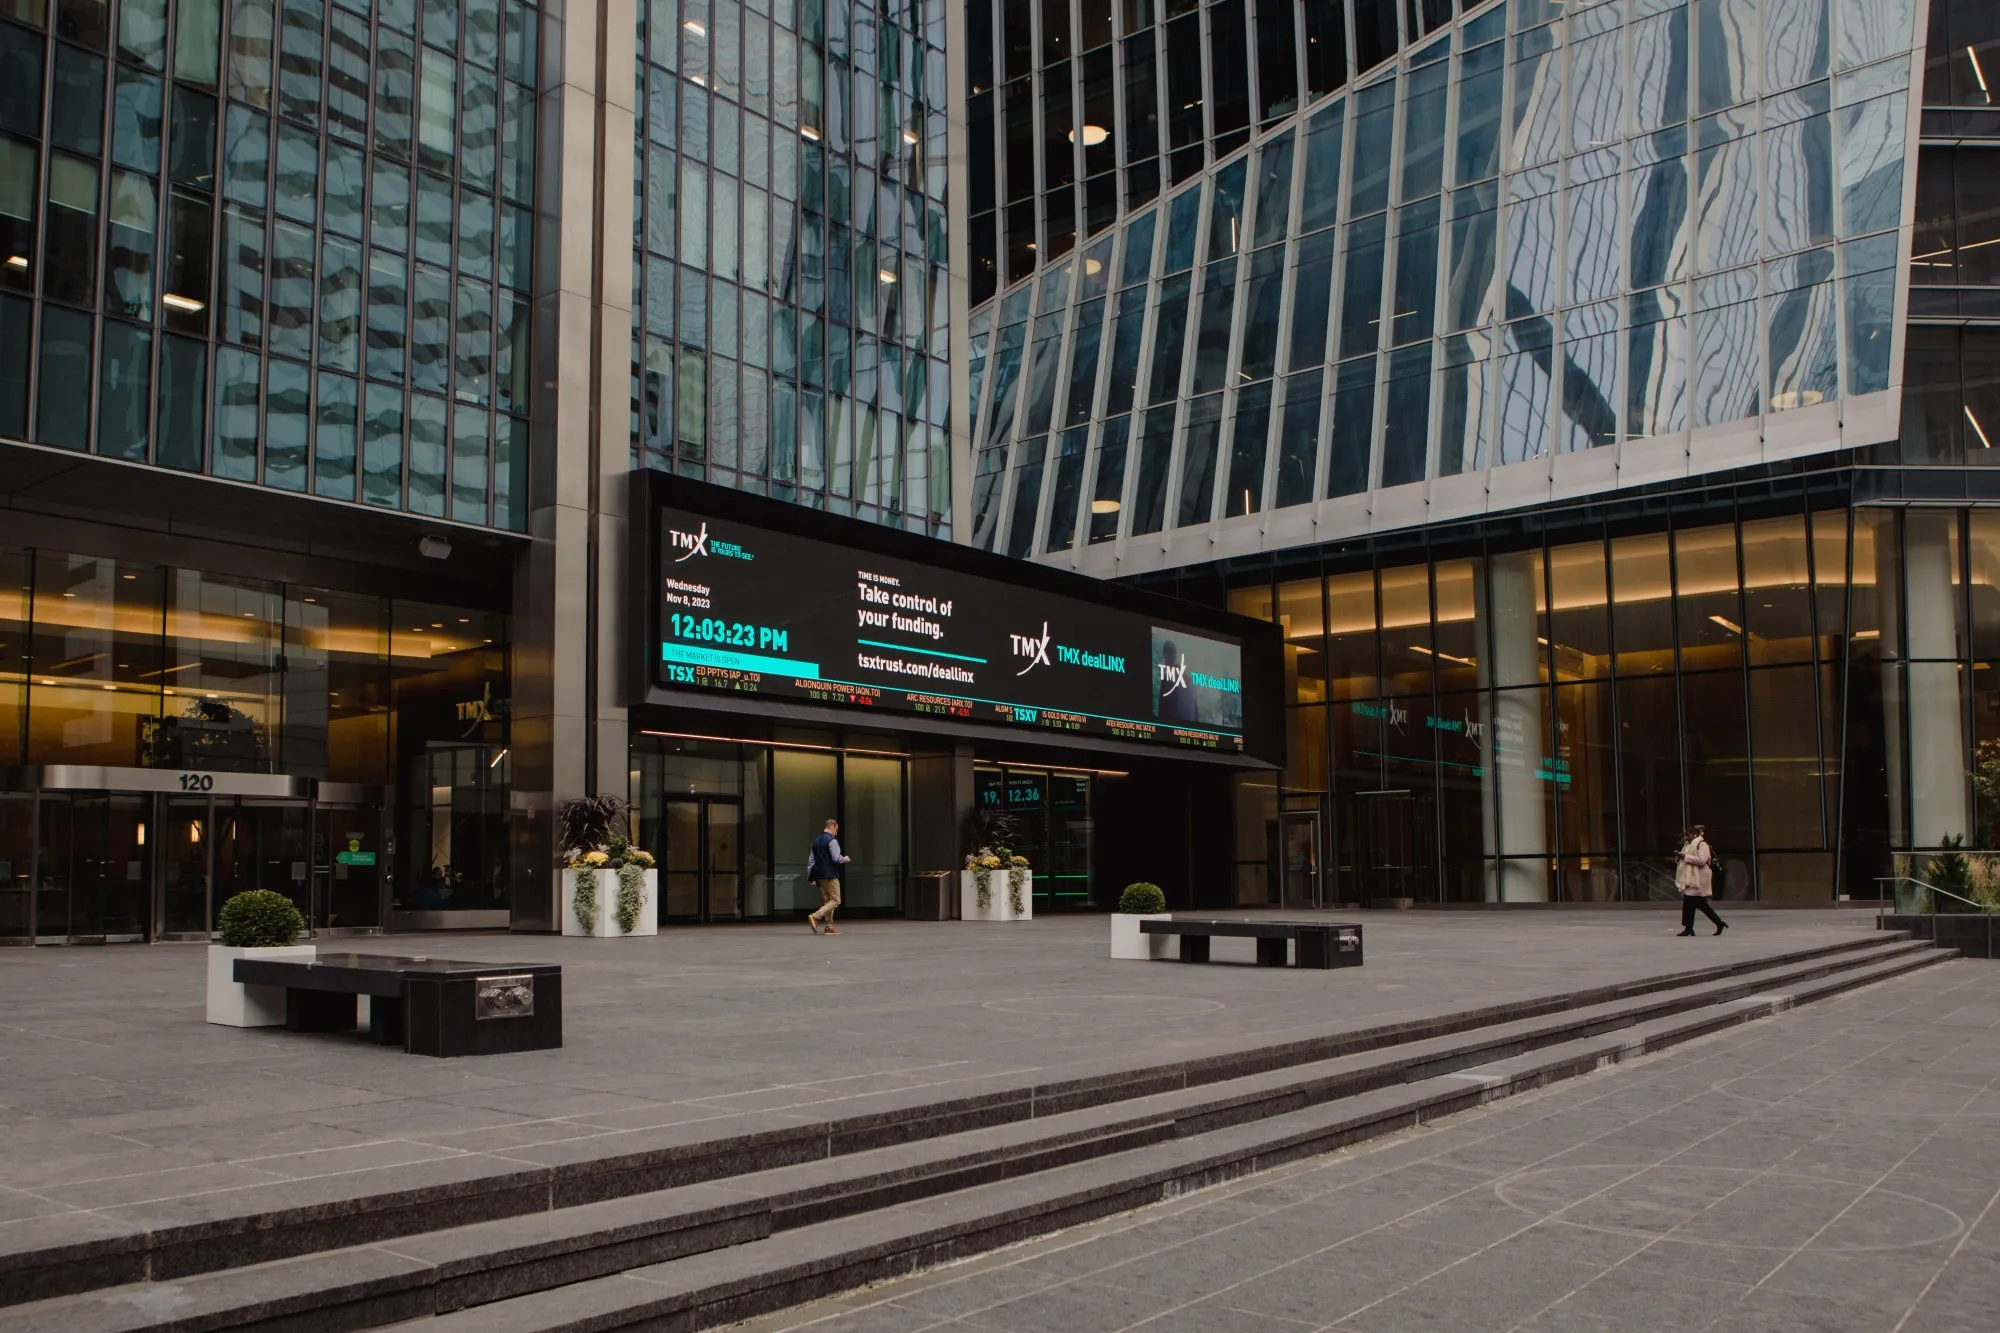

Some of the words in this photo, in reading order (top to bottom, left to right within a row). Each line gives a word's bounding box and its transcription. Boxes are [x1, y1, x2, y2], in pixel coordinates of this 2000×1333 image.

[669, 522, 708, 562] TMX
[710, 540, 720, 548] THE
[722, 542, 742, 552] FUTURE
[717, 548, 734, 556] YOURS
[666, 578, 710, 596] Wednesday
[858, 570, 872, 580] TIME
[873, 574, 878, 582] IS
[880, 576, 900, 586] MONEY.
[666, 592, 682, 604] Nov
[683, 596, 690, 607] 8,
[692, 596, 710, 608] 2023
[858, 582, 890, 604] Take
[892, 593, 938, 614] control
[940, 600, 952, 616] of
[671, 613, 755, 647] 12:03:23
[760, 626, 788, 652] PM
[858, 609, 890, 628] your
[892, 612, 944, 640] funding.
[672, 648, 684, 658] THE
[686, 650, 713, 662] MARKET
[714, 654, 720, 664] IS
[722, 654, 740, 666] OPEN
[1009, 621, 1051, 676] TMX
[858, 653, 974, 684] tsxtrust.com/deallinx
[1056, 645, 1080, 665] TMX
[1082, 650, 1126, 674] dealLINX
[668, 664, 695, 682] TSX
[696, 666, 706, 676] ED
[708, 667, 728, 679] PPTYS
[1158, 653, 1188, 697] TMX
[714, 678, 728, 688] 16.7
[744, 682, 758, 692] 0.24
[795, 678, 832, 691] ALGONQUIN
[833, 684, 854, 694] POWER
[1190, 672, 1208, 688] TMX
[1208, 676, 1240, 693] dealLINX
[809, 690, 820, 699] 100
[832, 692, 844, 702] 7.72
[906, 692, 918, 702] ARC
[920, 694, 951, 706] RESOURCES
[456, 681, 492, 738] TMX
[914, 704, 924, 712] 100
[934, 706, 946, 714] 21.5
[1014, 708, 1037, 722] TSXV
[179, 774, 214, 792] 120
[1008, 787, 1040, 802] 12.36
